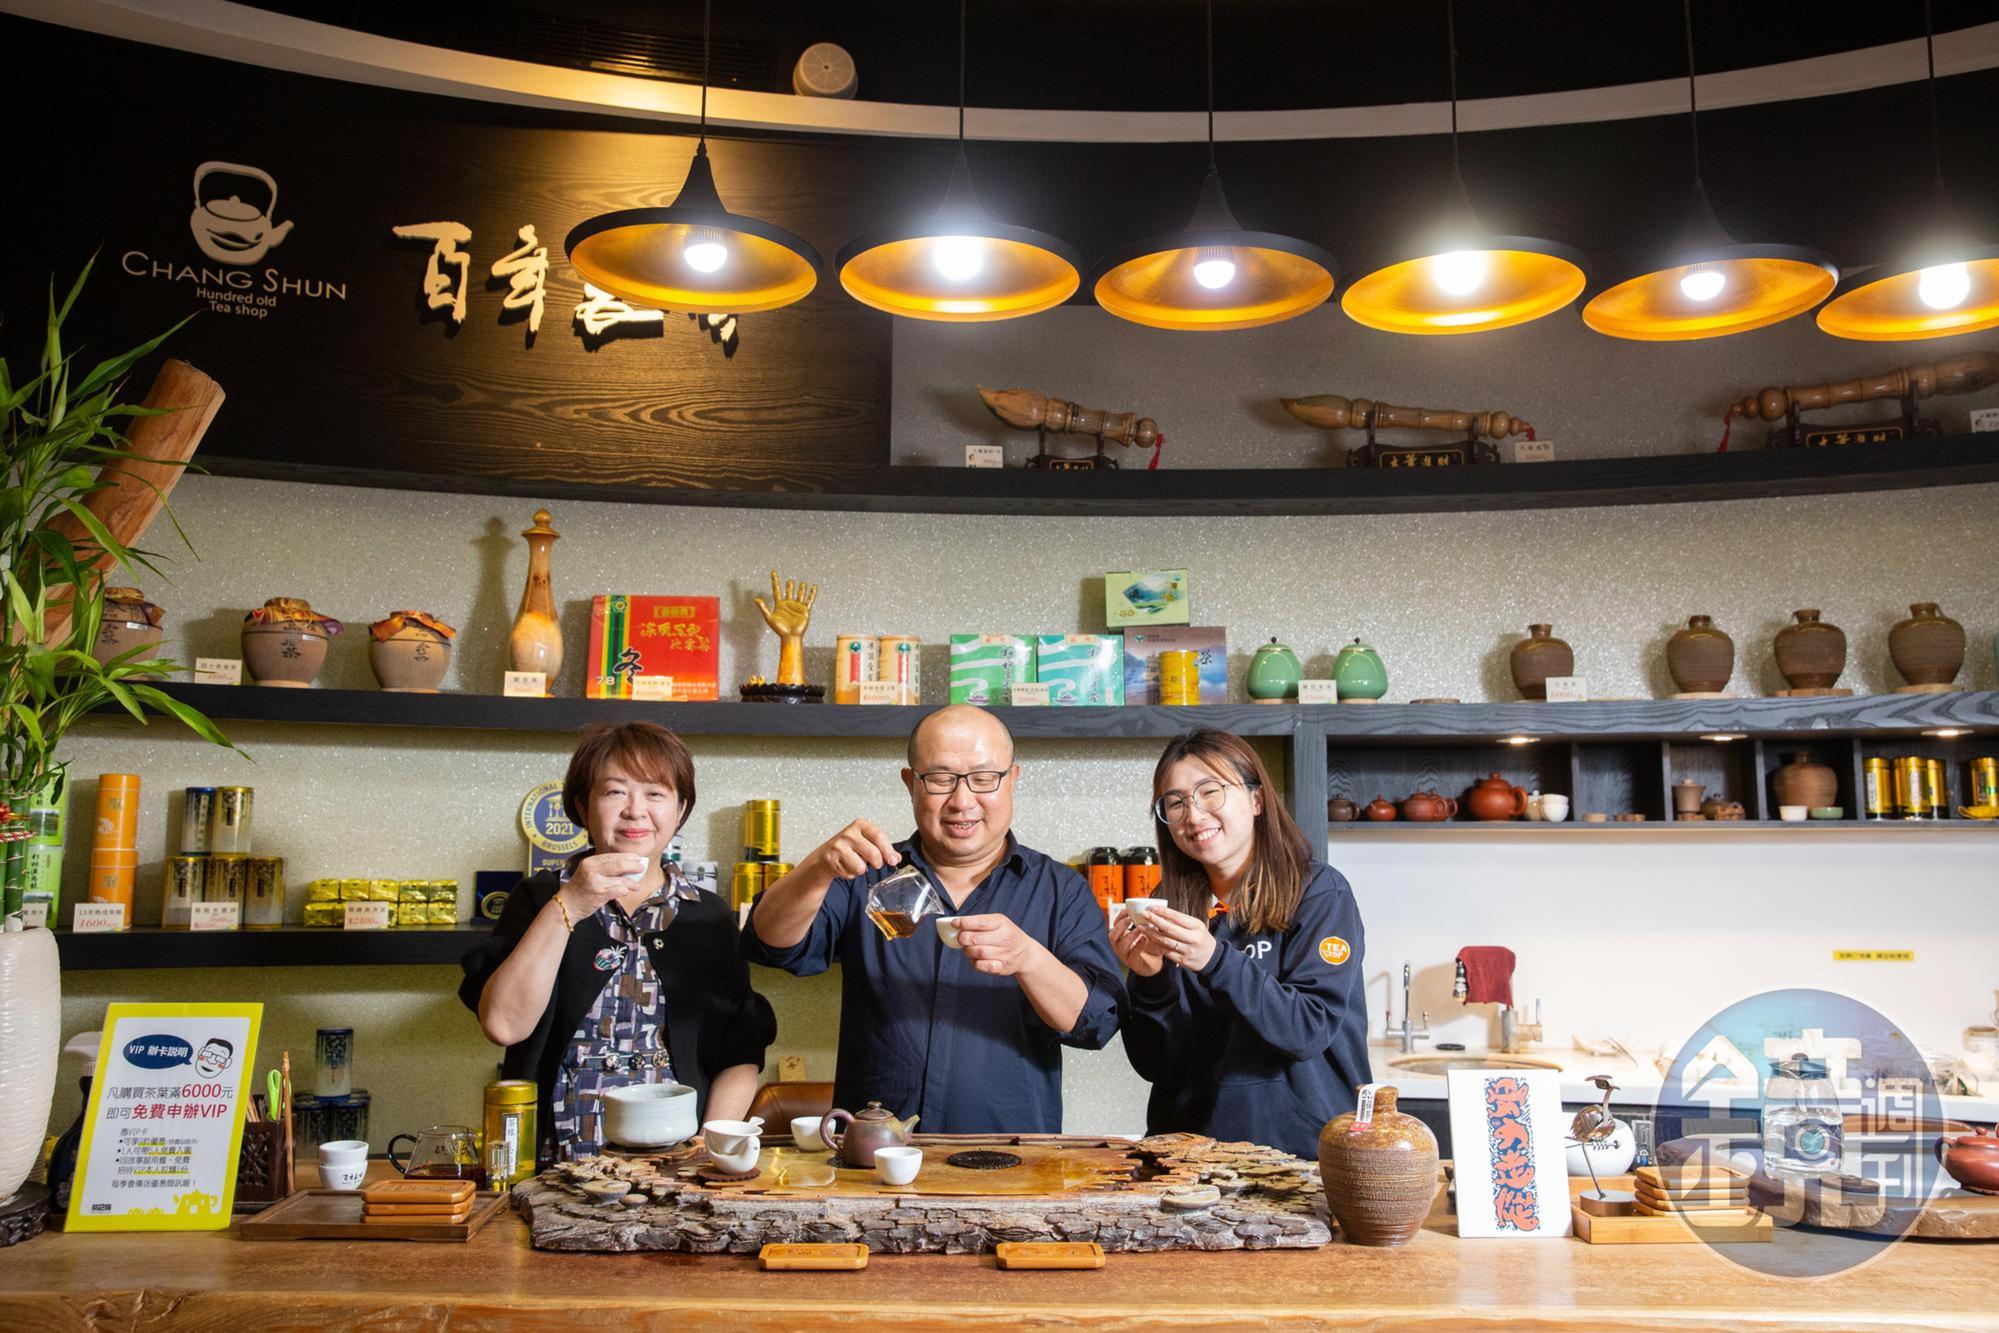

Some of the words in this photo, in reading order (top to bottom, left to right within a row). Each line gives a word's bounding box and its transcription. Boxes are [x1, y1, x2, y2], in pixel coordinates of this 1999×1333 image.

[263, 268, 347, 300] SHUN
[196, 287, 254, 304] Hundred
[256, 295, 277, 307] old
[209, 300, 231, 313] Tea
[234, 305, 268, 319] shop
[545, 822, 575, 836] 2021
[542, 840, 578, 851] BRUSSELS
[1327, 942, 1347, 952] TEA
[129, 1045, 145, 1055] VIP
[106, 1083, 234, 1100] 凡購買茶葉滿6000元
[106, 1103, 228, 1120] 即可免費申辦VIP
